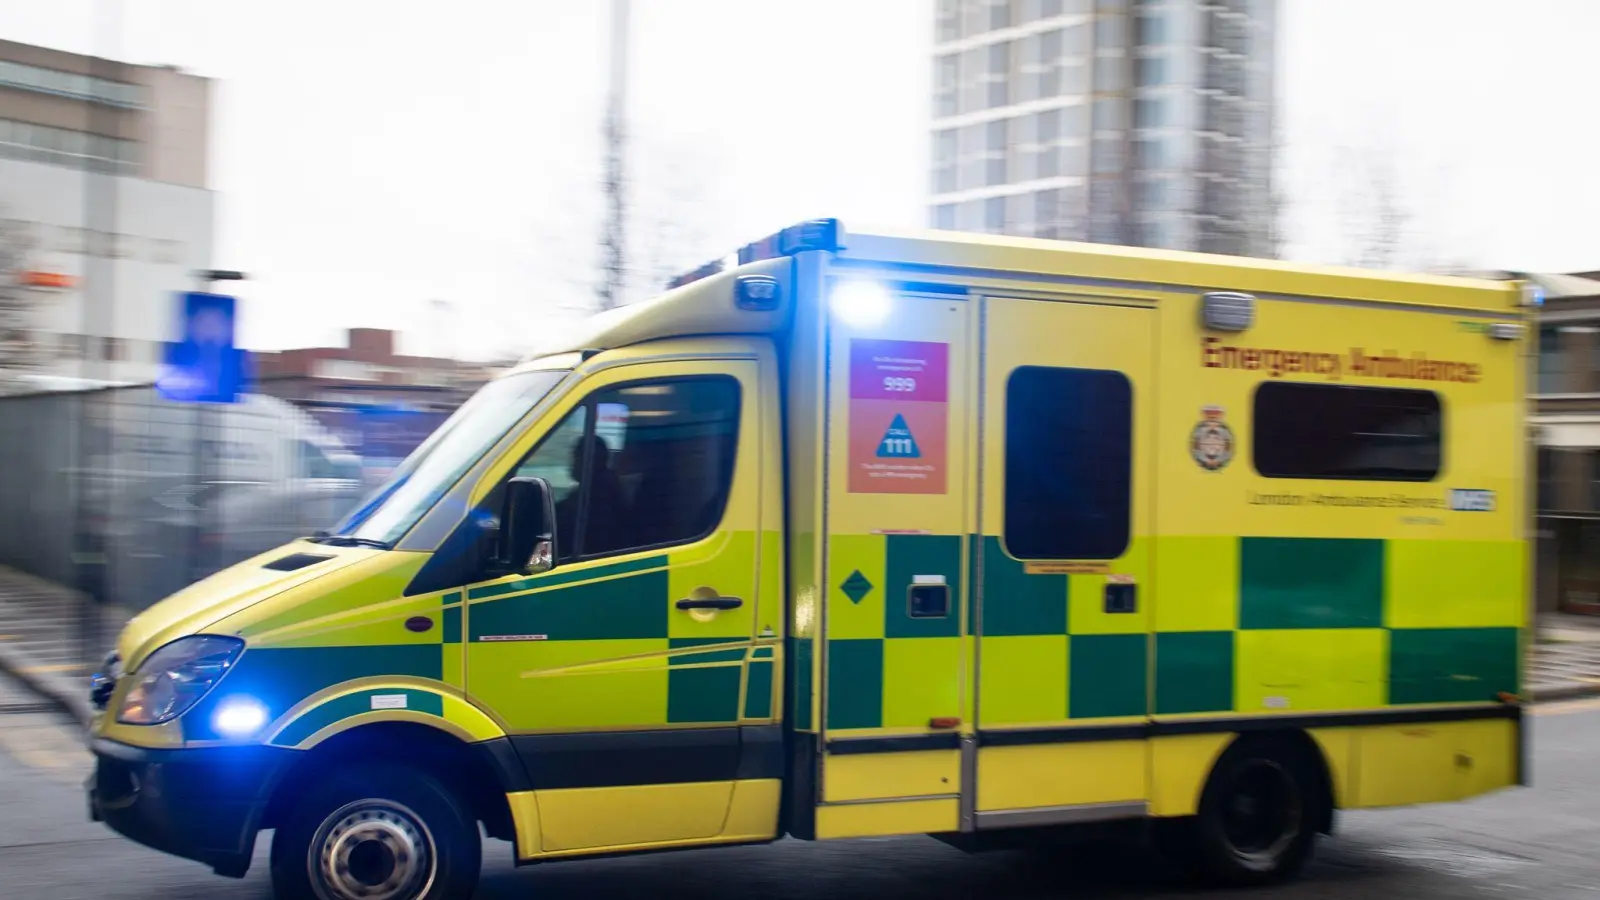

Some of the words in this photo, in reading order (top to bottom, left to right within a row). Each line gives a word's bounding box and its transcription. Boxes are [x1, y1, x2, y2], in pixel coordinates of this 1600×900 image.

[1201, 336, 1341, 380] Emergency
[1349, 346, 1482, 384] Ambulance
[883, 376, 916, 392] 999
[882, 438, 912, 454] 111
